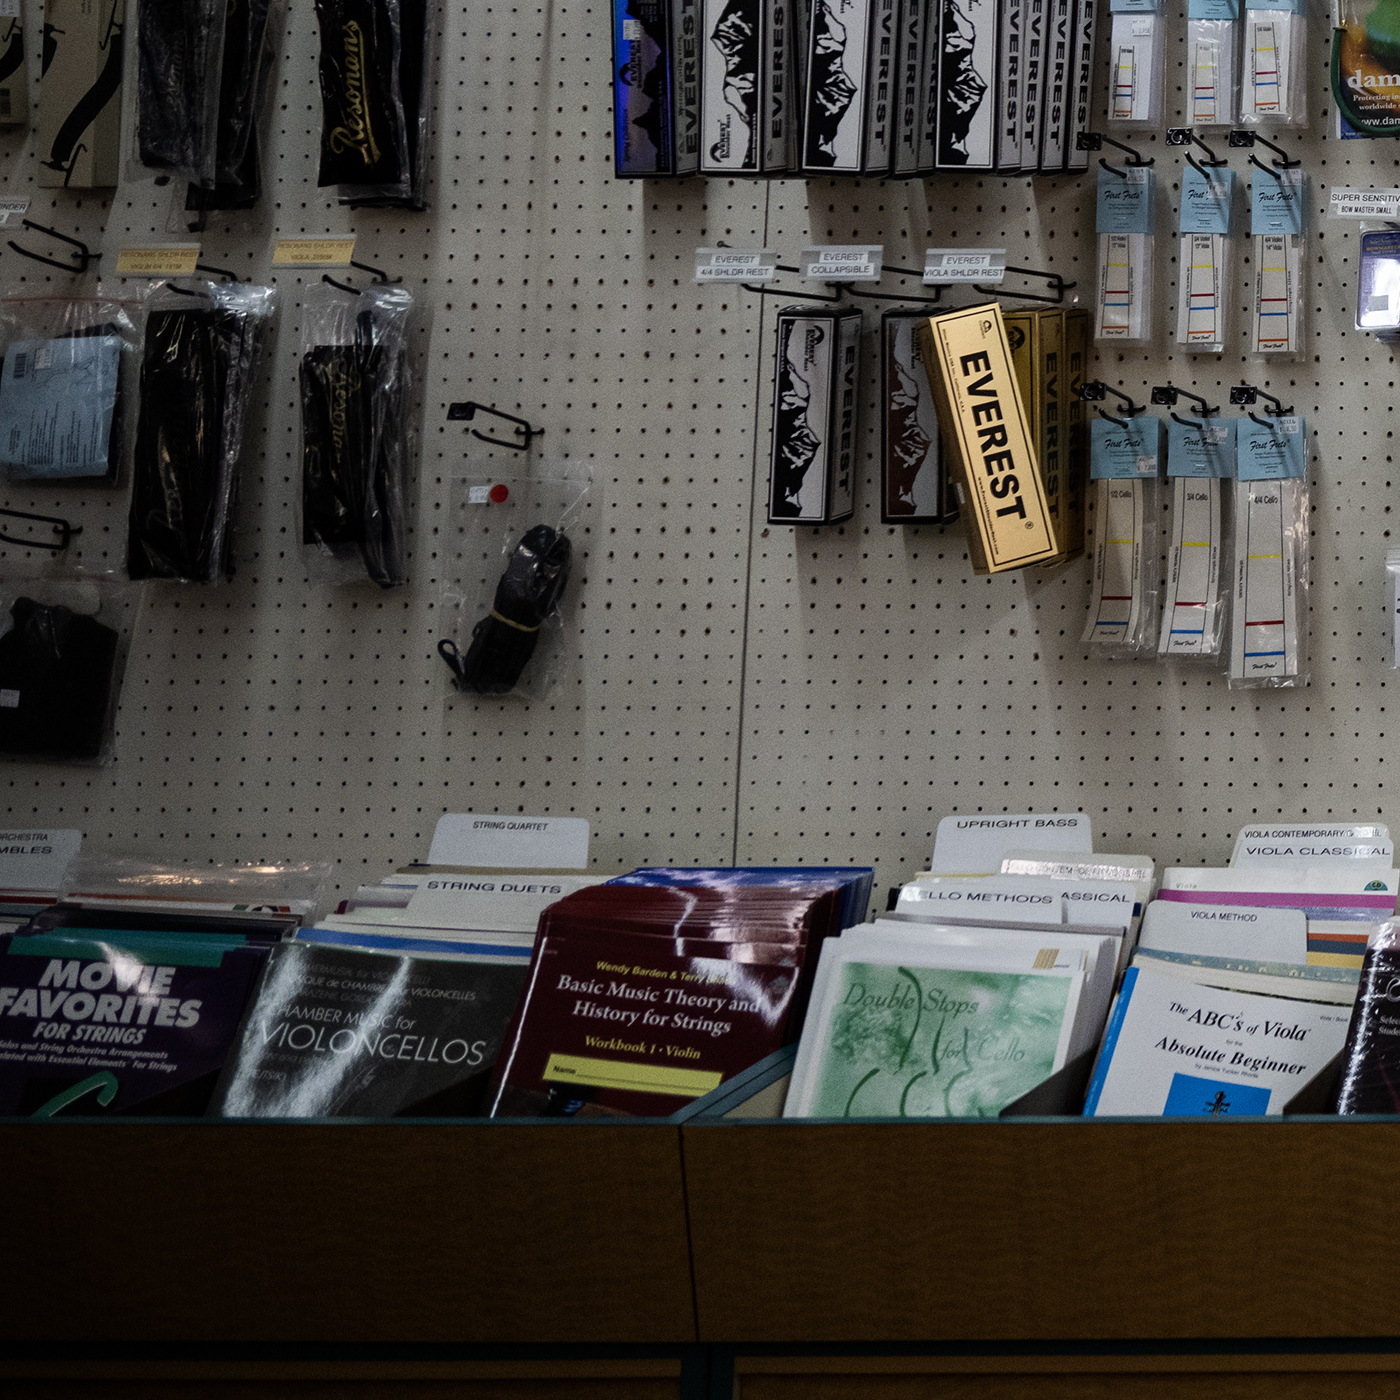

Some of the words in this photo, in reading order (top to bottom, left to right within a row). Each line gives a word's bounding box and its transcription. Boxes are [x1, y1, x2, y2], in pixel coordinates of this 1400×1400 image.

[1331, 194, 1357, 203] SUPER
[959, 351, 1026, 520] EVEREST
[957, 819, 1030, 829] UPRIGHT
[1035, 819, 1078, 828] BASS
[427, 880, 495, 892] STRING
[500, 883, 561, 894] DUETS
[557, 975, 603, 995] Basic
[606, 982, 659, 1002] Music
[664, 989, 726, 1013] Theory
[729, 997, 759, 1013] and
[572, 1001, 638, 1029] History
[641, 1009, 667, 1027] for
[671, 1011, 732, 1038] Strings
[1154, 1036, 1227, 1064] Absolute
[1230, 1047, 1306, 1077] Beginner
